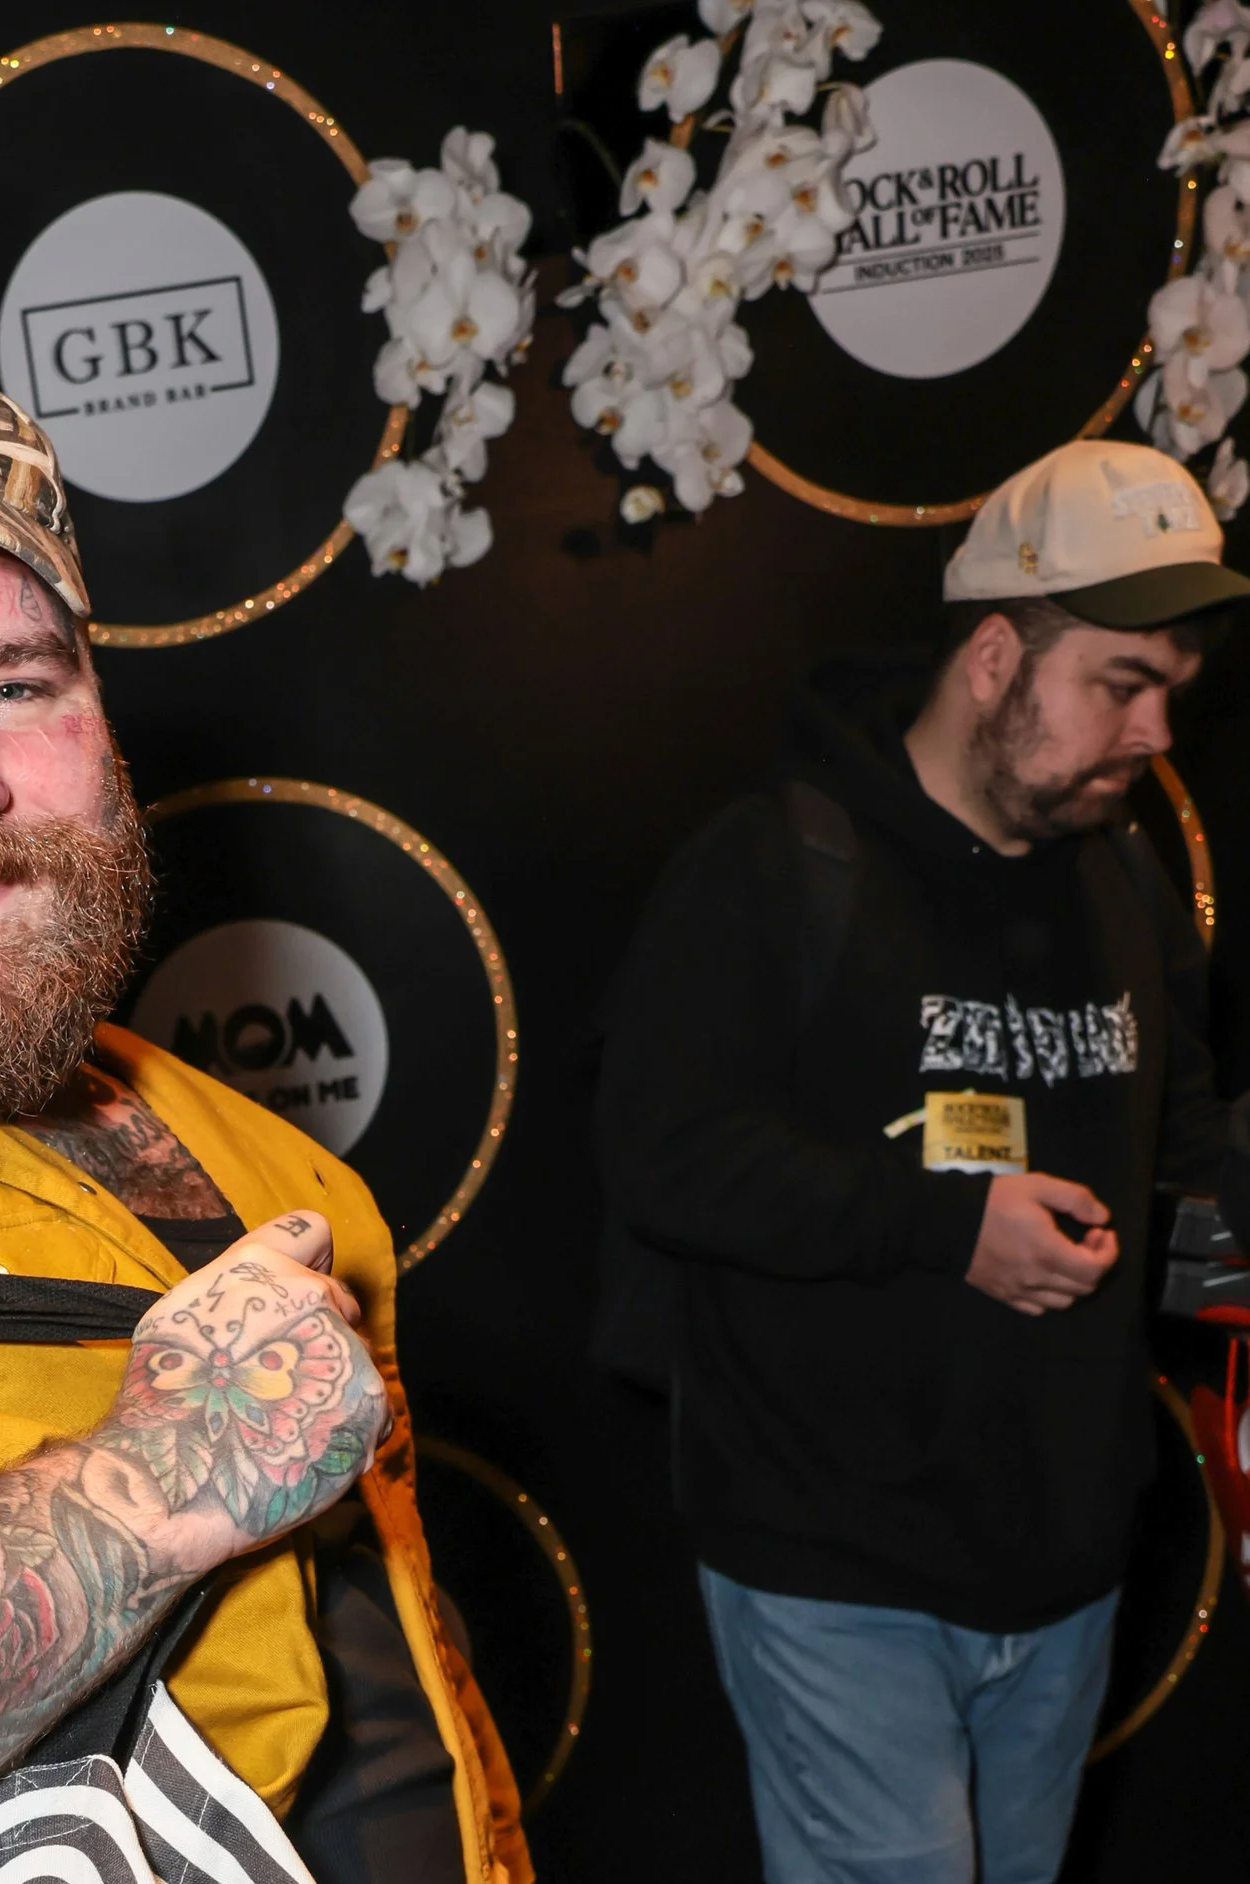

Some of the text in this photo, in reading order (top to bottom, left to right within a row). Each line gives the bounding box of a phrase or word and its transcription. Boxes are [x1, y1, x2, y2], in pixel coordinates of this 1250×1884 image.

[843, 170, 919, 214] OCK
[938, 154, 1041, 199] ROLL
[837, 190, 1042, 256] ALL OF FAME
[856, 245, 1004, 282] INDUCTION 2025
[52, 308, 223, 385] GBK
[83, 382, 209, 418] BRAND BAR
[318, 1076, 361, 1103] ME
[941, 1143, 1013, 1161] TALENT
